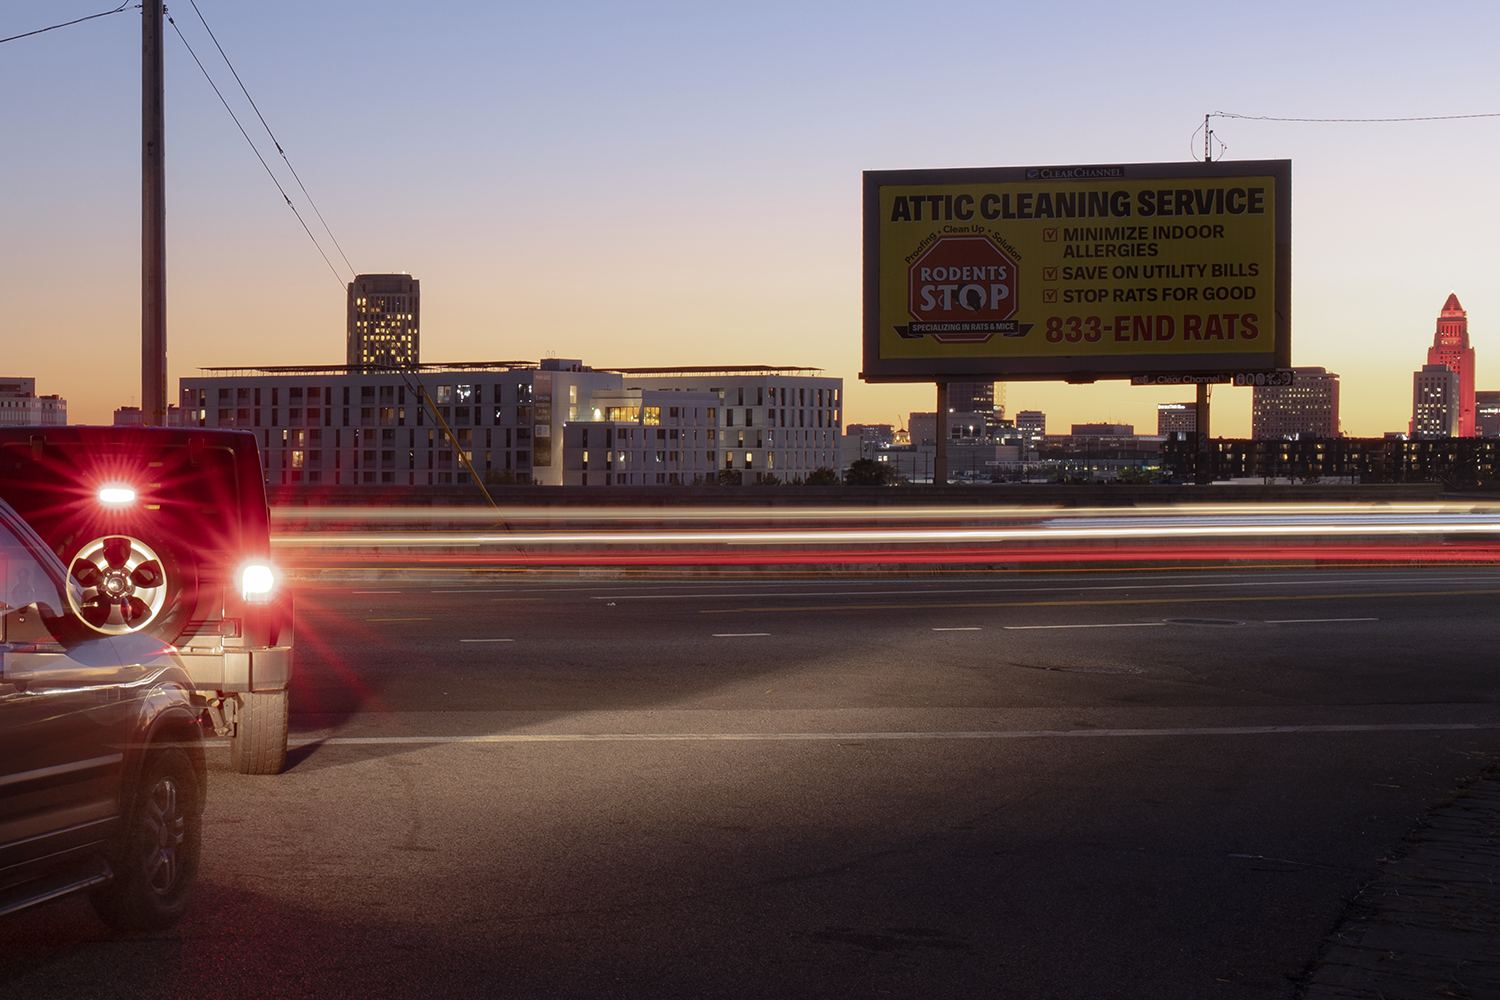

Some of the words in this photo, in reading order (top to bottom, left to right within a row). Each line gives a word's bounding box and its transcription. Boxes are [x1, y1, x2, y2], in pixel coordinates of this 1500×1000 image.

[890, 194, 975, 222] ATTIC
[980, 190, 1132, 220] CLEANING
[1137, 187, 1265, 216] SERVICE
[1063, 226, 1148, 241] MINIMIZE
[1152, 225, 1224, 240] INDOOR
[904, 231, 938, 265] Proofing
[943, 225, 970, 234] Clean
[971, 224, 985, 235] Up
[991, 231, 1022, 262] Solution
[1063, 243, 1159, 258] ALLERGIES
[920, 265, 1007, 282] RODENTS
[1062, 266, 1111, 281] SAVE
[1114, 265, 1139, 280] ON
[1142, 263, 1208, 279] UTILITY
[1211, 262, 1259, 277] BILLS
[920, 283, 1009, 312] STOP
[1062, 288, 1109, 303] STOP
[1112, 288, 1159, 302] RATS
[1162, 287, 1199, 301] FOR
[1202, 286, 1256, 300] GOOD
[912, 323, 961, 332] SPECIALIZING
[962, 323, 970, 331] IN
[971, 323, 989, 331] RATS
[996, 322, 1015, 330] MICE
[1045, 315, 1175, 343] 833-END
[1183, 314, 1260, 342] RATS
[1157, 376, 1181, 384] Clear
[1182, 375, 1220, 384] Channel
